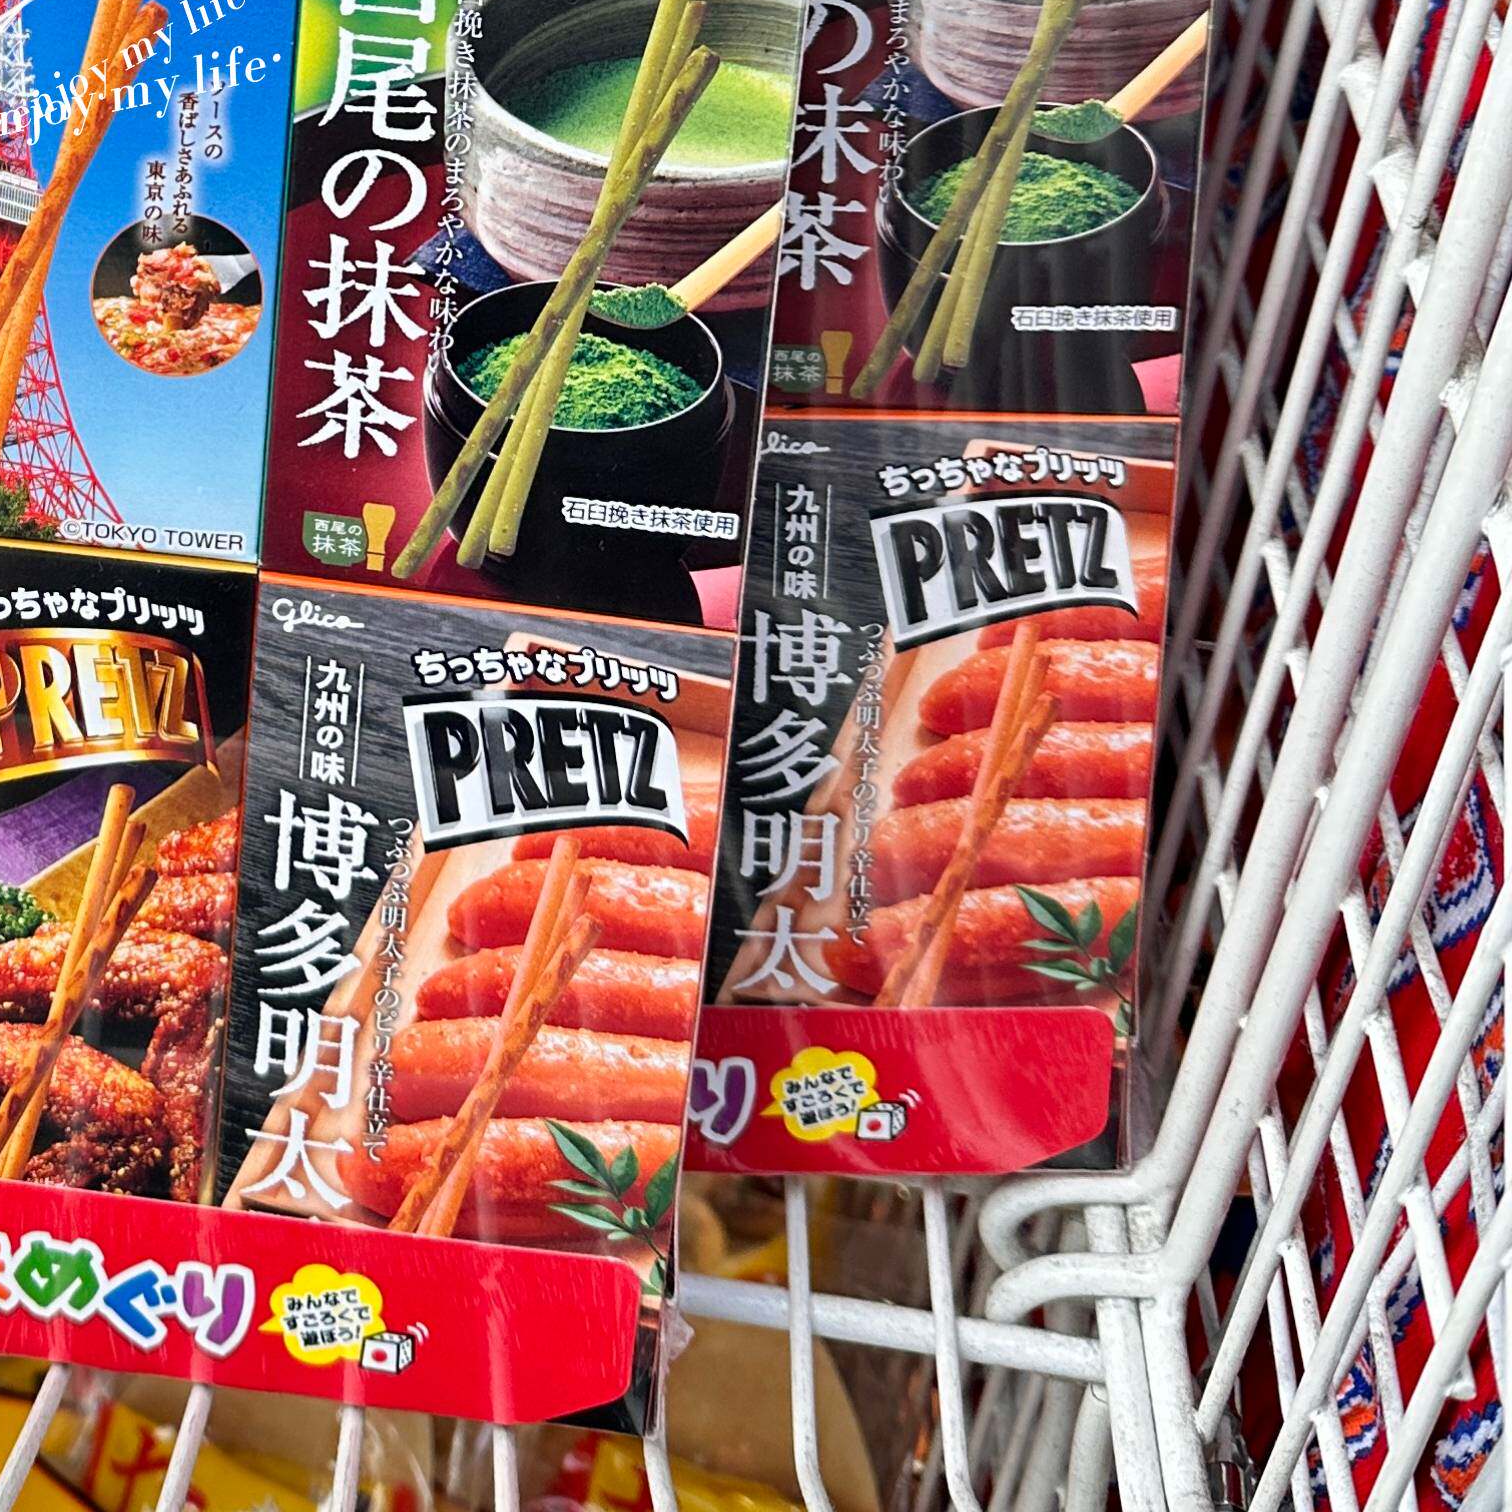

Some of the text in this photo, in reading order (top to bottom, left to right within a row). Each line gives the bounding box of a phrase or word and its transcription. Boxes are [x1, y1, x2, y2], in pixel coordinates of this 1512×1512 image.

[142, 160, 167, 244] 東京の味
[172, 92, 199, 234] 香ばしさあふれる
[880, 449, 1124, 495] ちっちゃなプリッツ
[164, 528, 244, 552] TOWER
[312, 534, 363, 558] 抹茶
[783, 486, 819, 599] 九州の味
[890, 504, 1120, 625] PRETZ
[272, 597, 365, 632] Glico
[308, 659, 350, 786] 九州の味
[415, 650, 676, 699] ちっちゃなプリッツ
[422, 708, 669, 826] PRETZ
[734, 609, 854, 994] 博多明太
[240, 788, 382, 1210] 博多明太
